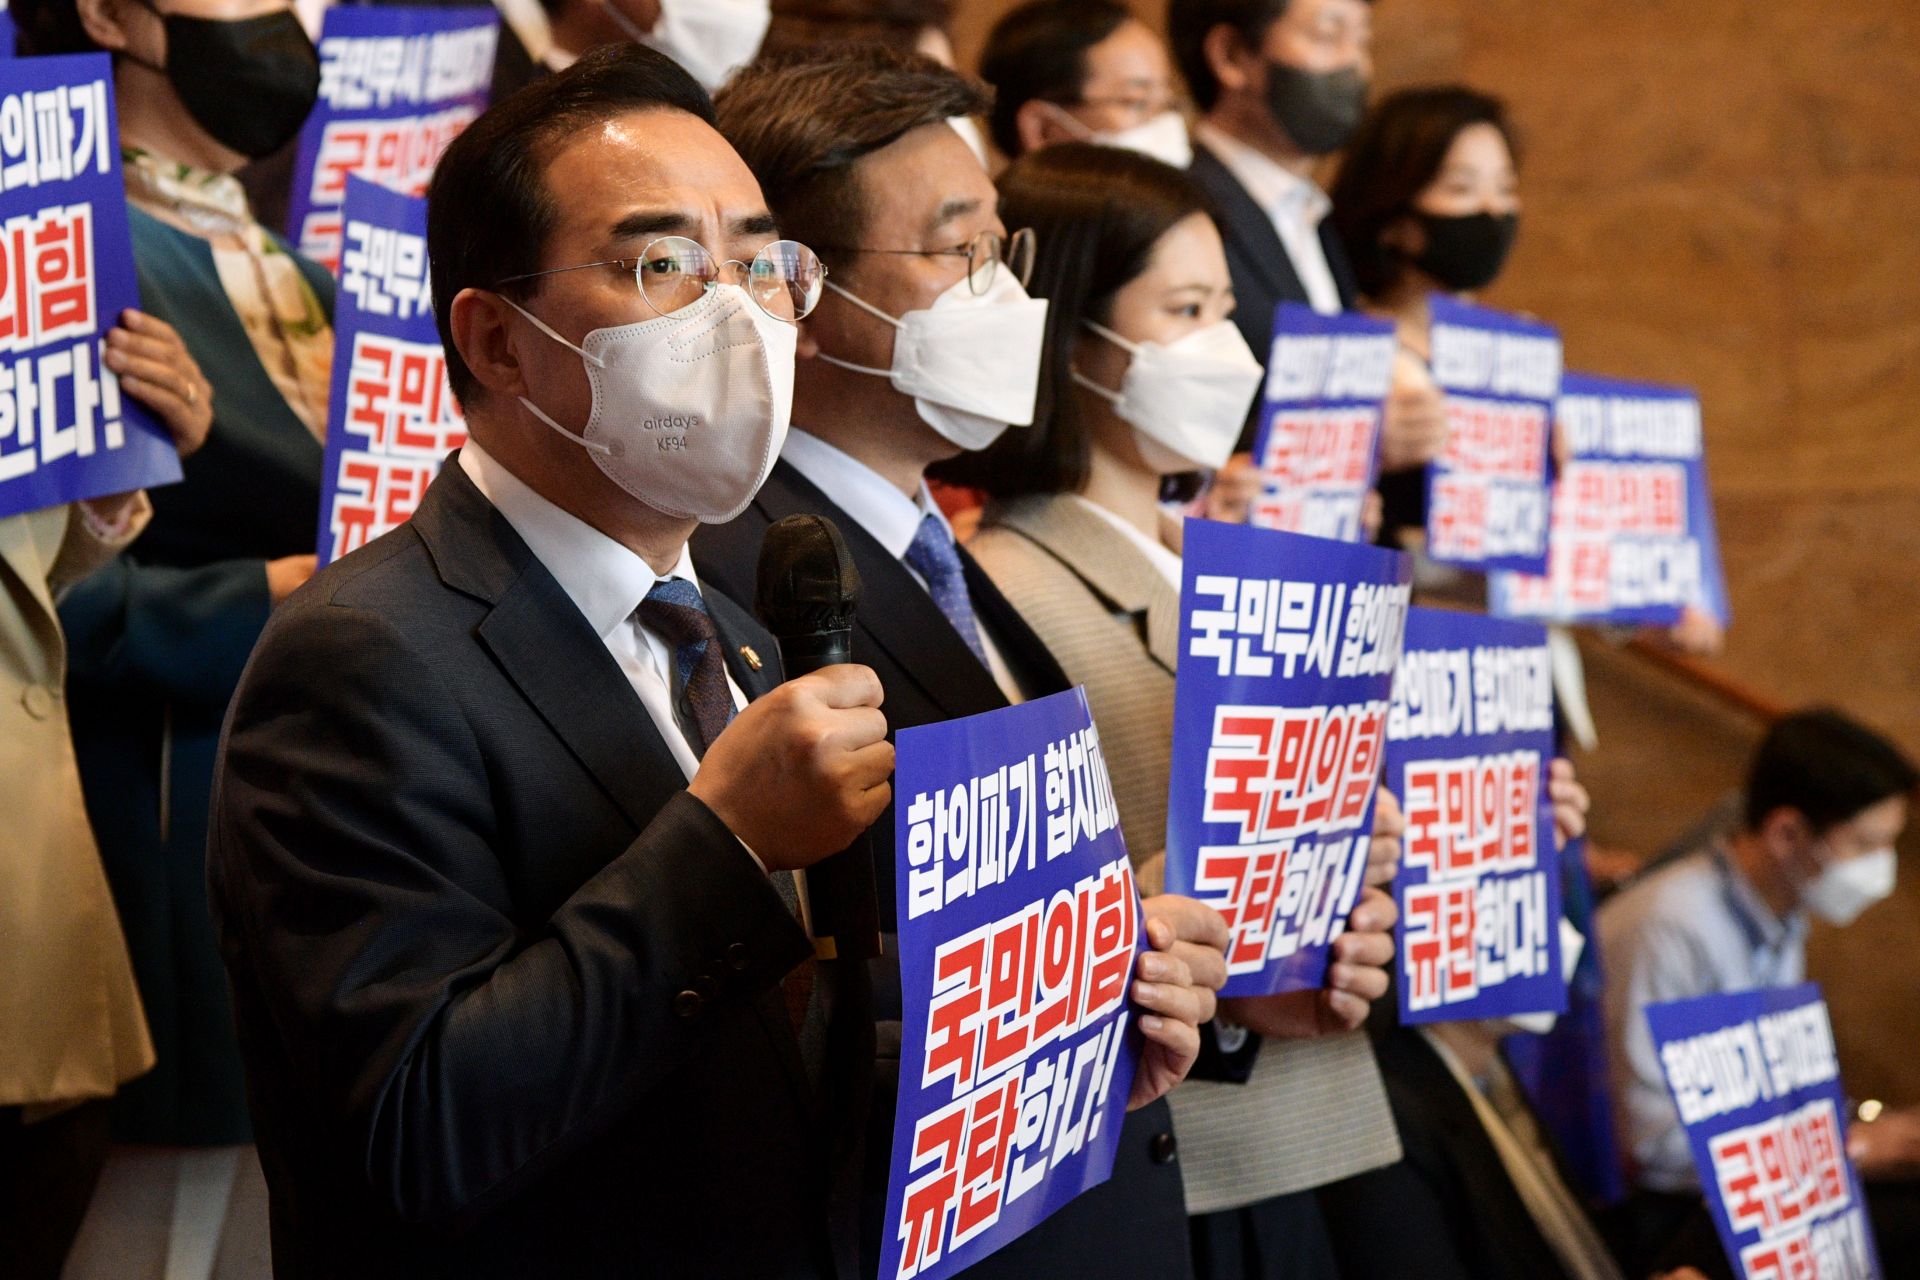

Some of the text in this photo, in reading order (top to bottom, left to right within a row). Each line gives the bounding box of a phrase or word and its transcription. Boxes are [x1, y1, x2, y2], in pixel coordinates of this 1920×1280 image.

[0, 80, 110, 193] 의파기
[643, 415, 699, 430] airdays
[656, 435, 687, 452] KF94
[1190, 575, 1412, 679] 국민무시 합의파
[907, 720, 1119, 920] 합의파기 협치파
[1203, 700, 1391, 845] 국민의힘
[1403, 750, 1541, 882] 국민의힘
[922, 854, 1141, 1100] 국민의힘
[1403, 872, 1549, 1011] 규탄한다!
[896, 1011, 1129, 1280] 규탄한다!
